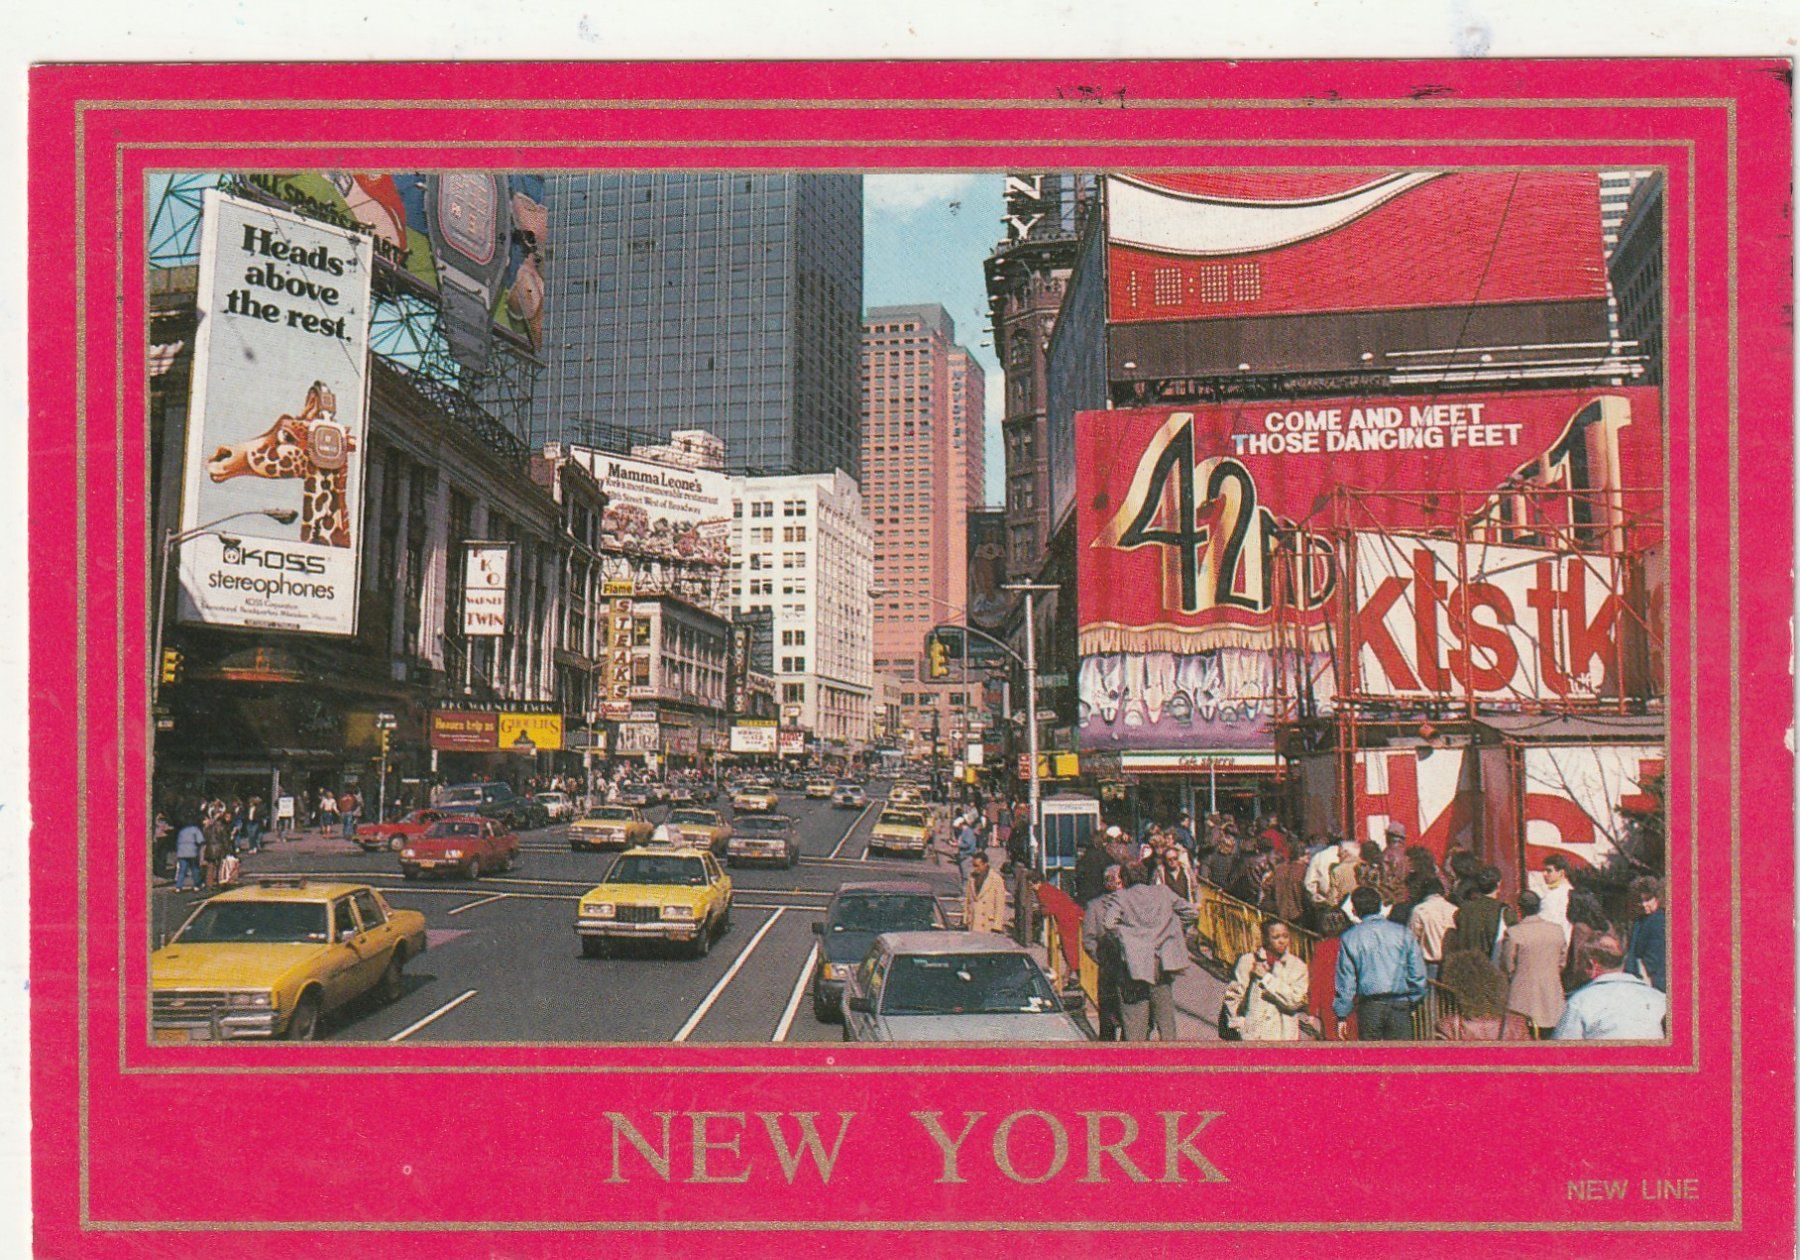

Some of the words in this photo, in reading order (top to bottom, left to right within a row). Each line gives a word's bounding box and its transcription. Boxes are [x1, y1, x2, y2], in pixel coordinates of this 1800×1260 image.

[241, 224, 344, 277] Heads
[244, 262, 340, 306] above
[227, 289, 280, 323] the
[287, 309, 352, 342] rest.
[1265, 410, 1342, 432] COME
[1349, 407, 1402, 430] AND
[1410, 403, 1485, 427] MEET
[1231, 431, 1320, 455] THOSE
[1326, 426, 1444, 452] DANCING
[1449, 424, 1523, 447] FEET
[608, 462, 660, 487] Mamma
[660, 472, 703, 493] Leone's
[241, 548, 326, 575] KOSS
[208, 570, 335, 600] stereophones
[603, 582, 633, 595] Flame
[467, 612, 504, 626] TWIN
[613, 600, 631, 700] STEAKS
